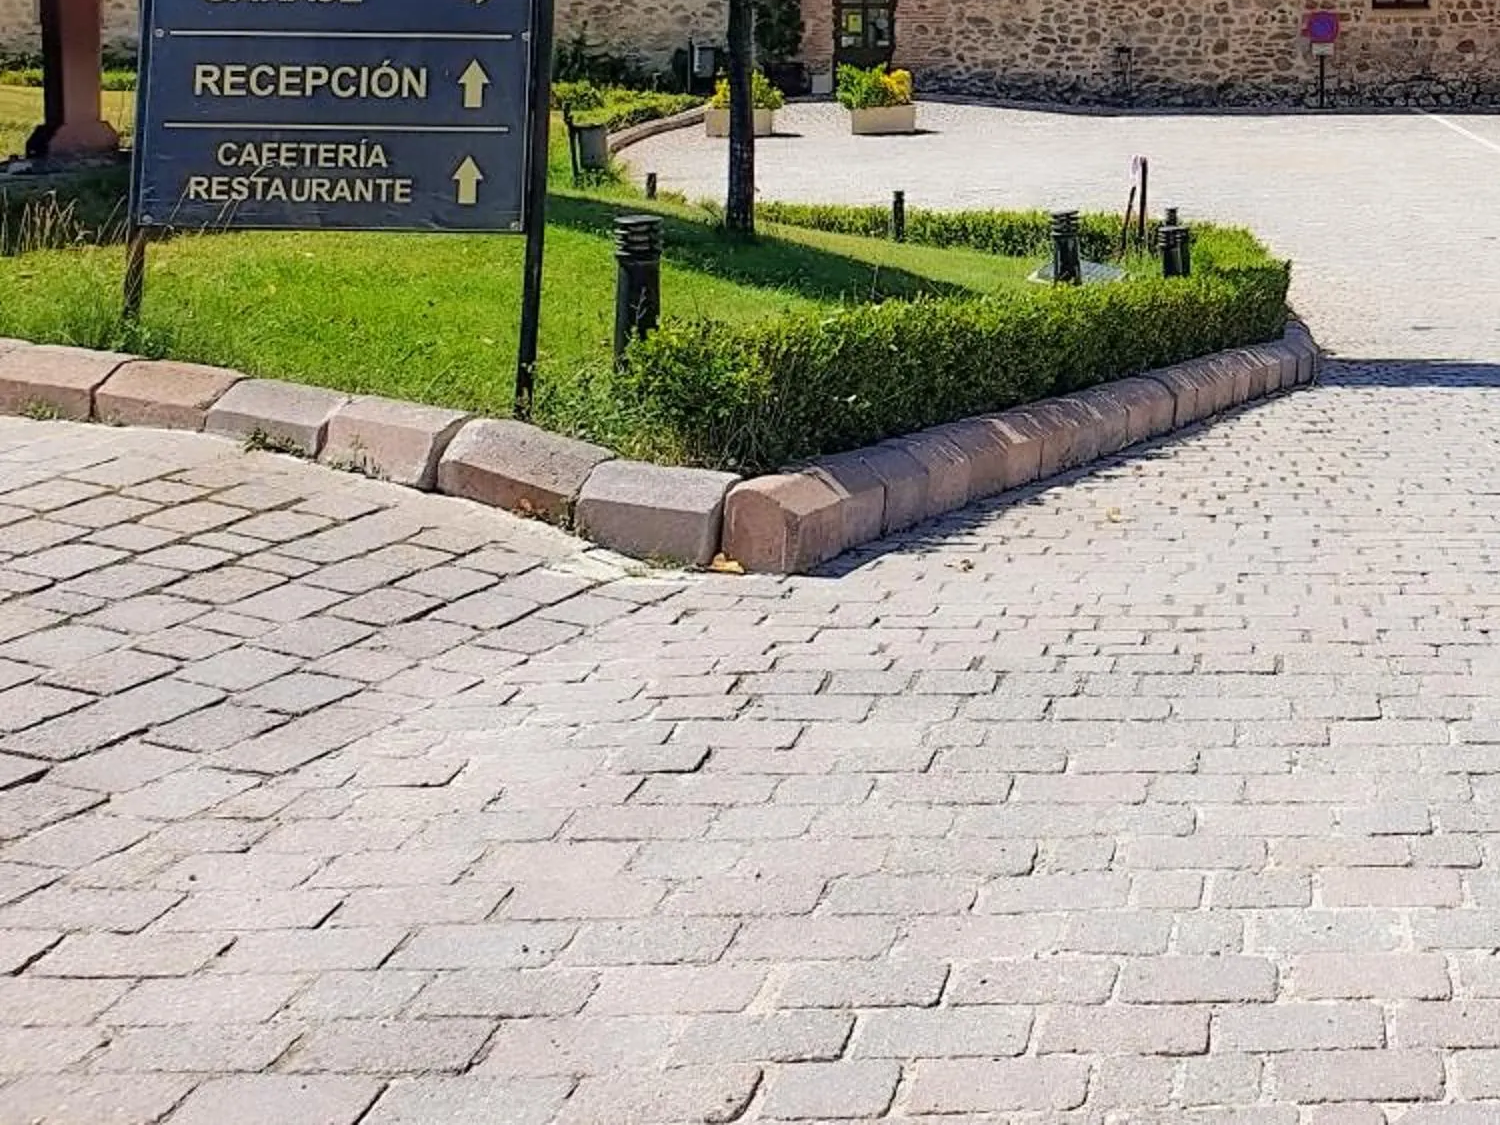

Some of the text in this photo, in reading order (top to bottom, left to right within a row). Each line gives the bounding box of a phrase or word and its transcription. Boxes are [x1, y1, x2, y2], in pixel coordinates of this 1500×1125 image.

[193, 59, 428, 99] RECEPCIÓN
[217, 138, 388, 169] CAFETERÍA
[188, 176, 412, 204] RESTAURANTE
